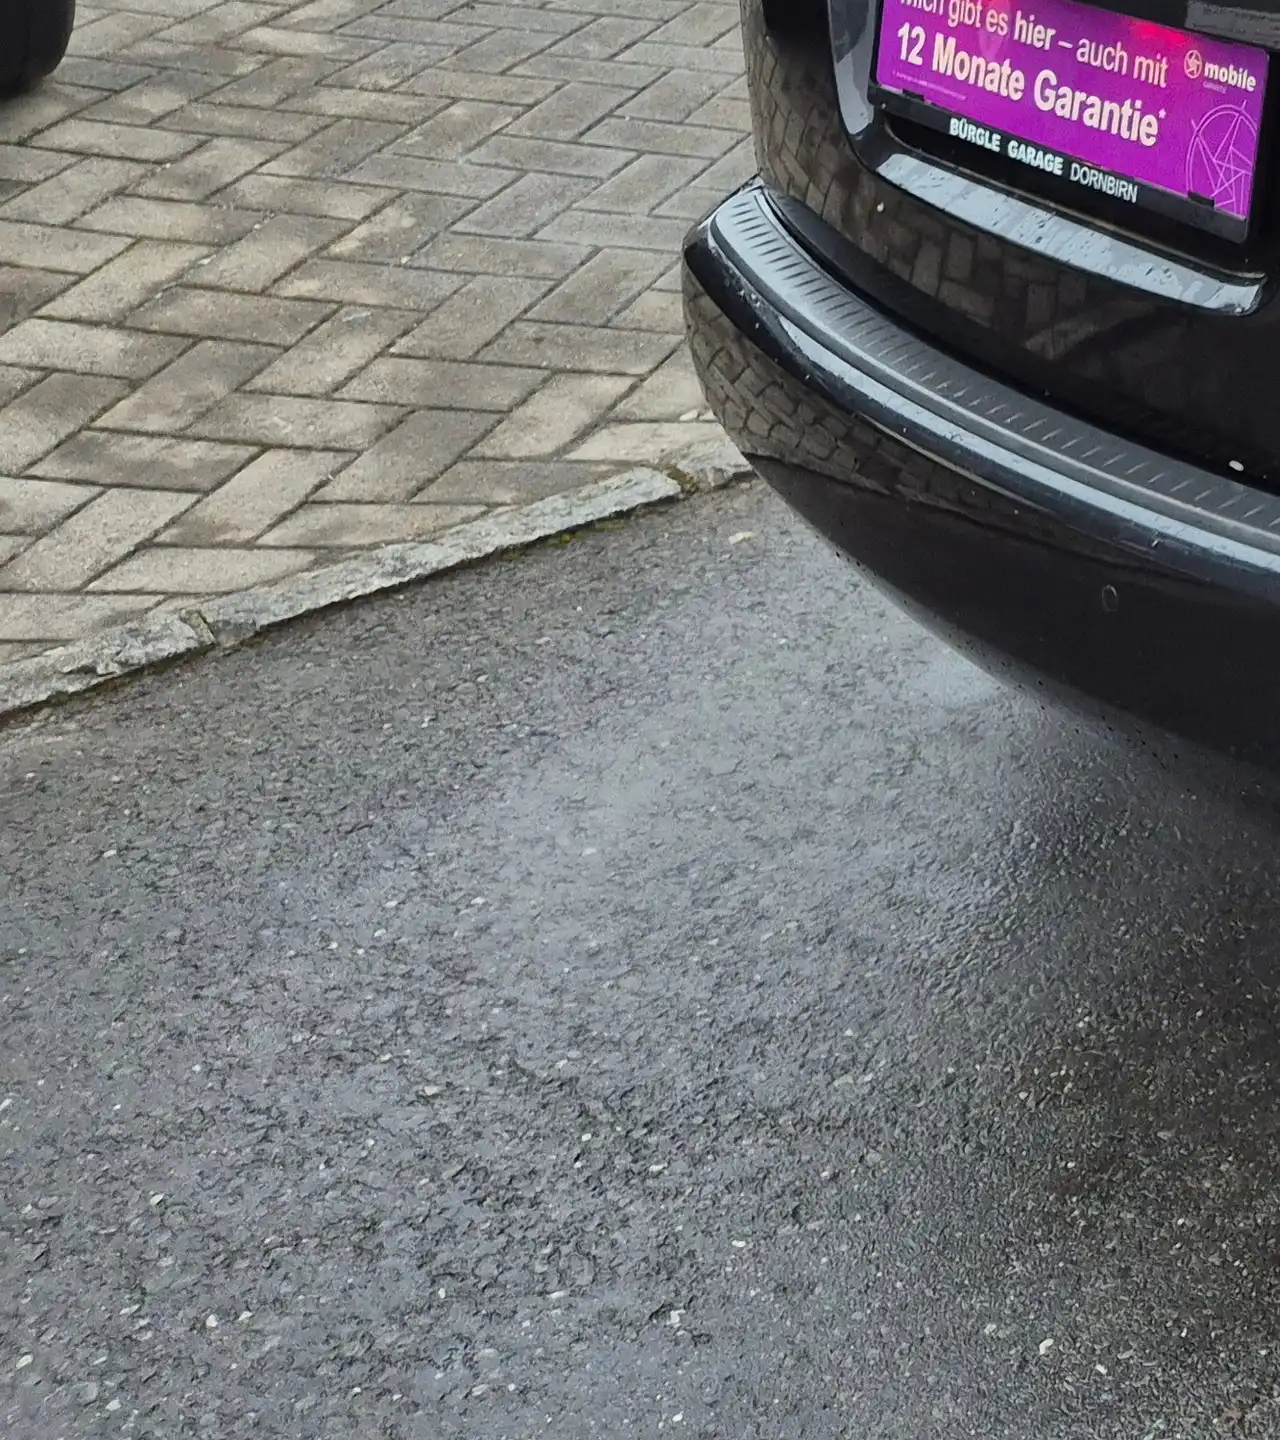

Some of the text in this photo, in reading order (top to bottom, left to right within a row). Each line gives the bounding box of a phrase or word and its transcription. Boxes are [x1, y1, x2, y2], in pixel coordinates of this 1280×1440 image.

[897, 21, 927, 66] 12
[931, 31, 1026, 101] Monate
[985, 7, 1009, 36] es
[1013, 10, 1056, 50] hier
[1076, 38, 1128, 76] auch
[1133, 53, 1169, 88] mit
[1203, 61, 1257, 93] mobile
[949, 117, 1139, 204] BÜRGLE GARAGE DORNBIRN
